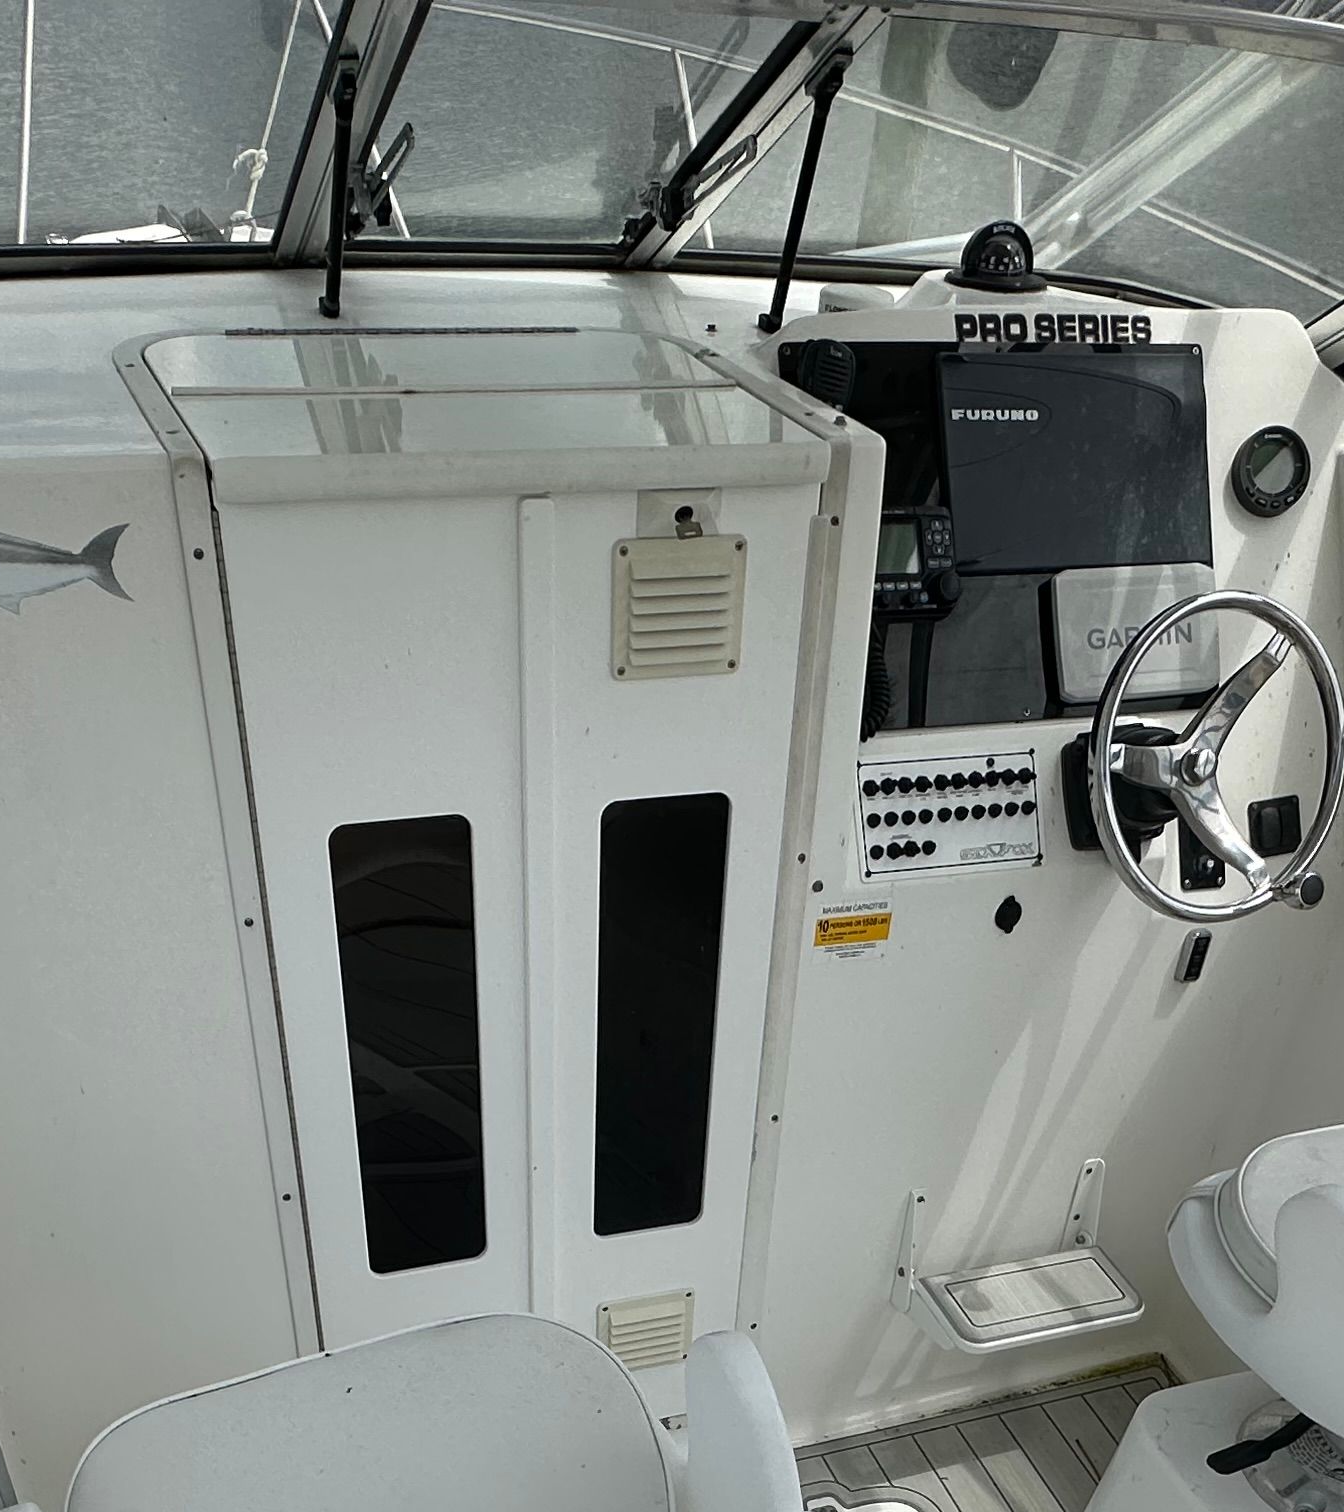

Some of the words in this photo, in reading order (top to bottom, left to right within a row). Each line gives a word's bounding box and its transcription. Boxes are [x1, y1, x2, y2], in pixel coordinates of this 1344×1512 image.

[954, 313, 1028, 343] PRO
[1034, 313, 1152, 344] SERIES
[951, 408, 1039, 421] FURUNO
[1087, 622, 1193, 649] GARIN
[817, 919, 830, 933] 10
